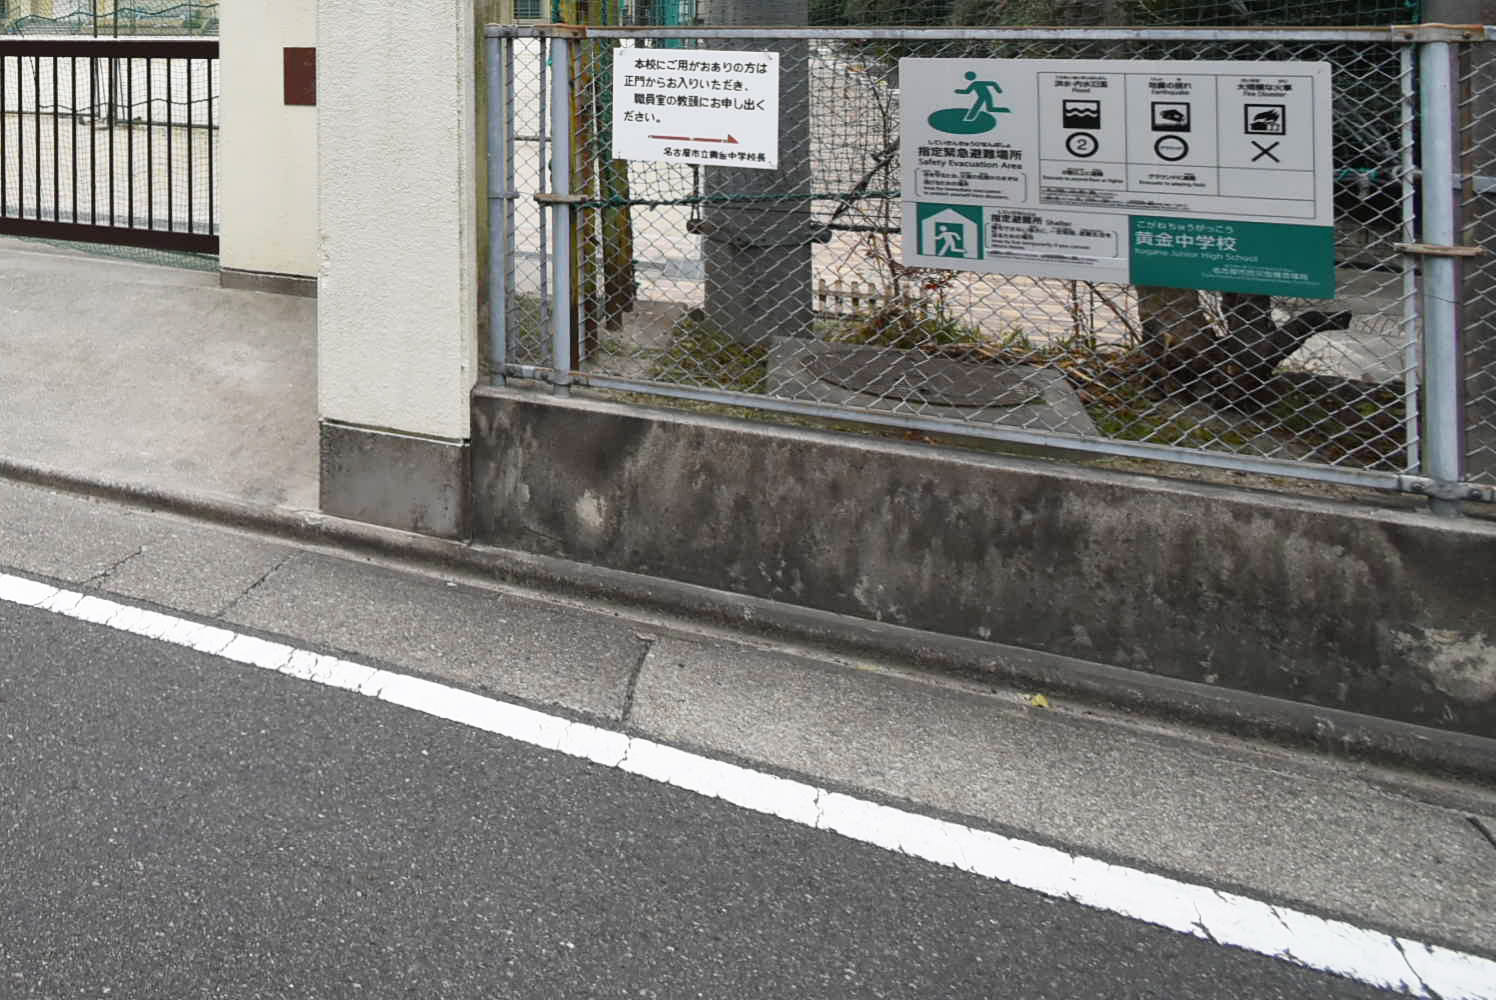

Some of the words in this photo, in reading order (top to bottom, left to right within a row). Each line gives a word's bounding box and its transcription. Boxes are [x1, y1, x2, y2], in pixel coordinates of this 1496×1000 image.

[634, 58, 768, 74] 本校にご用がおありの方は
[634, 93, 767, 111] 職員室の教頭にお申し出く
[624, 111, 662, 124] ださい。
[1076, 138, 1088, 151] 2
[918, 146, 1022, 161] 指定緊急避難場所
[918, 158, 946, 167] Safety
[948, 159, 998, 169] Evacuation
[1000, 161, 1023, 170] Area
[1134, 231, 1238, 252] 黄金中学校
[1201, 251, 1224, 261] High
[1225, 252, 1259, 264] School
